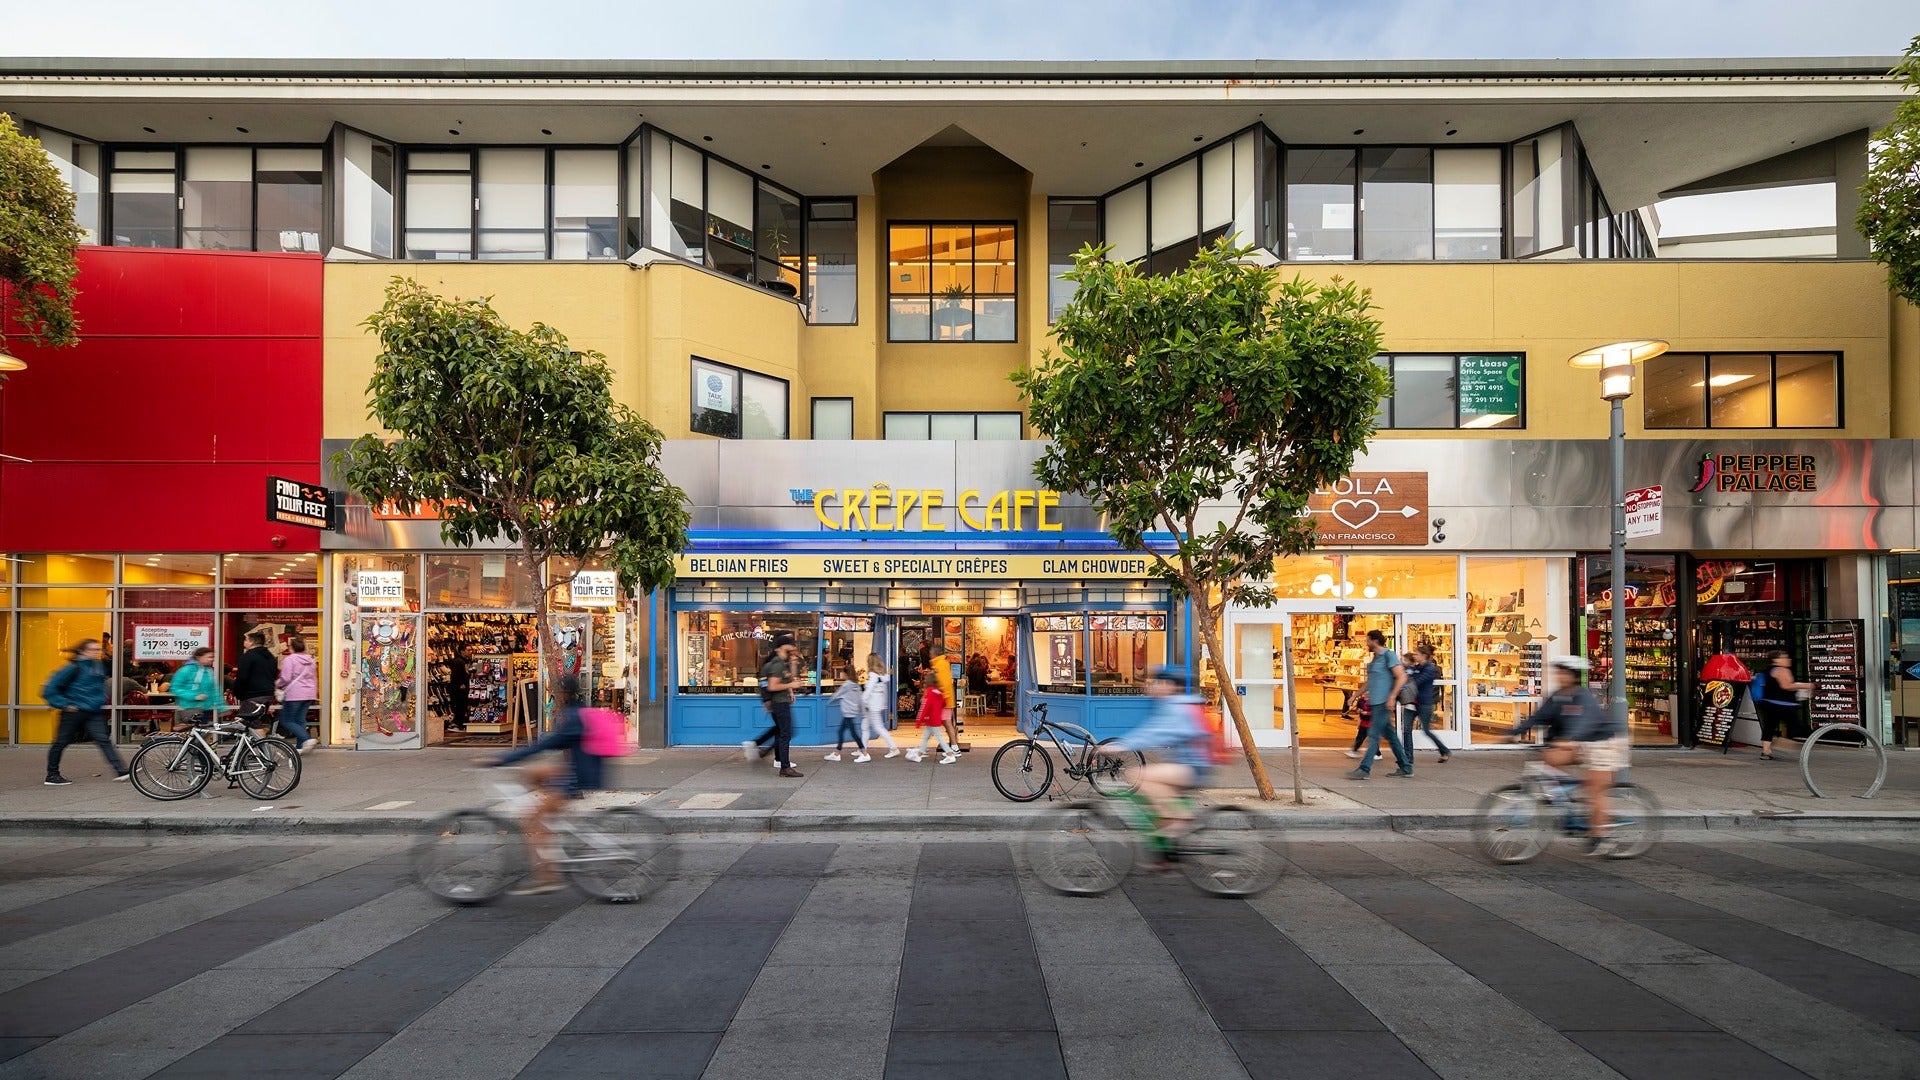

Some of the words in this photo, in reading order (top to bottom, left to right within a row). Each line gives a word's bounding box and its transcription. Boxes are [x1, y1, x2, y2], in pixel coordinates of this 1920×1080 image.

[1460, 359, 1476, 367] For
[1480, 360, 1508, 368] Lease
[1717, 455, 1816, 471] PEPPER
[276, 480, 300, 498] FIND
[1717, 473, 1817, 491] PALACE
[276, 494, 303, 513] YOUR
[304, 500, 327, 518] FEET
[789, 488, 814, 502] THE
[813, 480, 946, 532] CRÊPE
[1626, 503, 1637, 512] NO
[1637, 500, 1660, 510] STOPPING
[1627, 516, 1641, 525] ANY
[1643, 512, 1659, 522] TIME
[690, 559, 747, 573] BELGIAN
[750, 559, 788, 573] FRIES
[823, 559, 869, 573] SWEET
[873, 562, 880, 573] &
[884, 559, 952, 573] SPECIALTY
[956, 557, 1007, 573] CRÊPES
[1043, 559, 1078, 573] CLAM
[1081, 559, 1145, 573] CHOWDER
[360, 576, 378, 585] FIND
[360, 586, 380, 596] YOUR
[382, 586, 401, 596] FEET
[574, 586, 593, 596] YOUR
[596, 586, 614, 596] FEET
